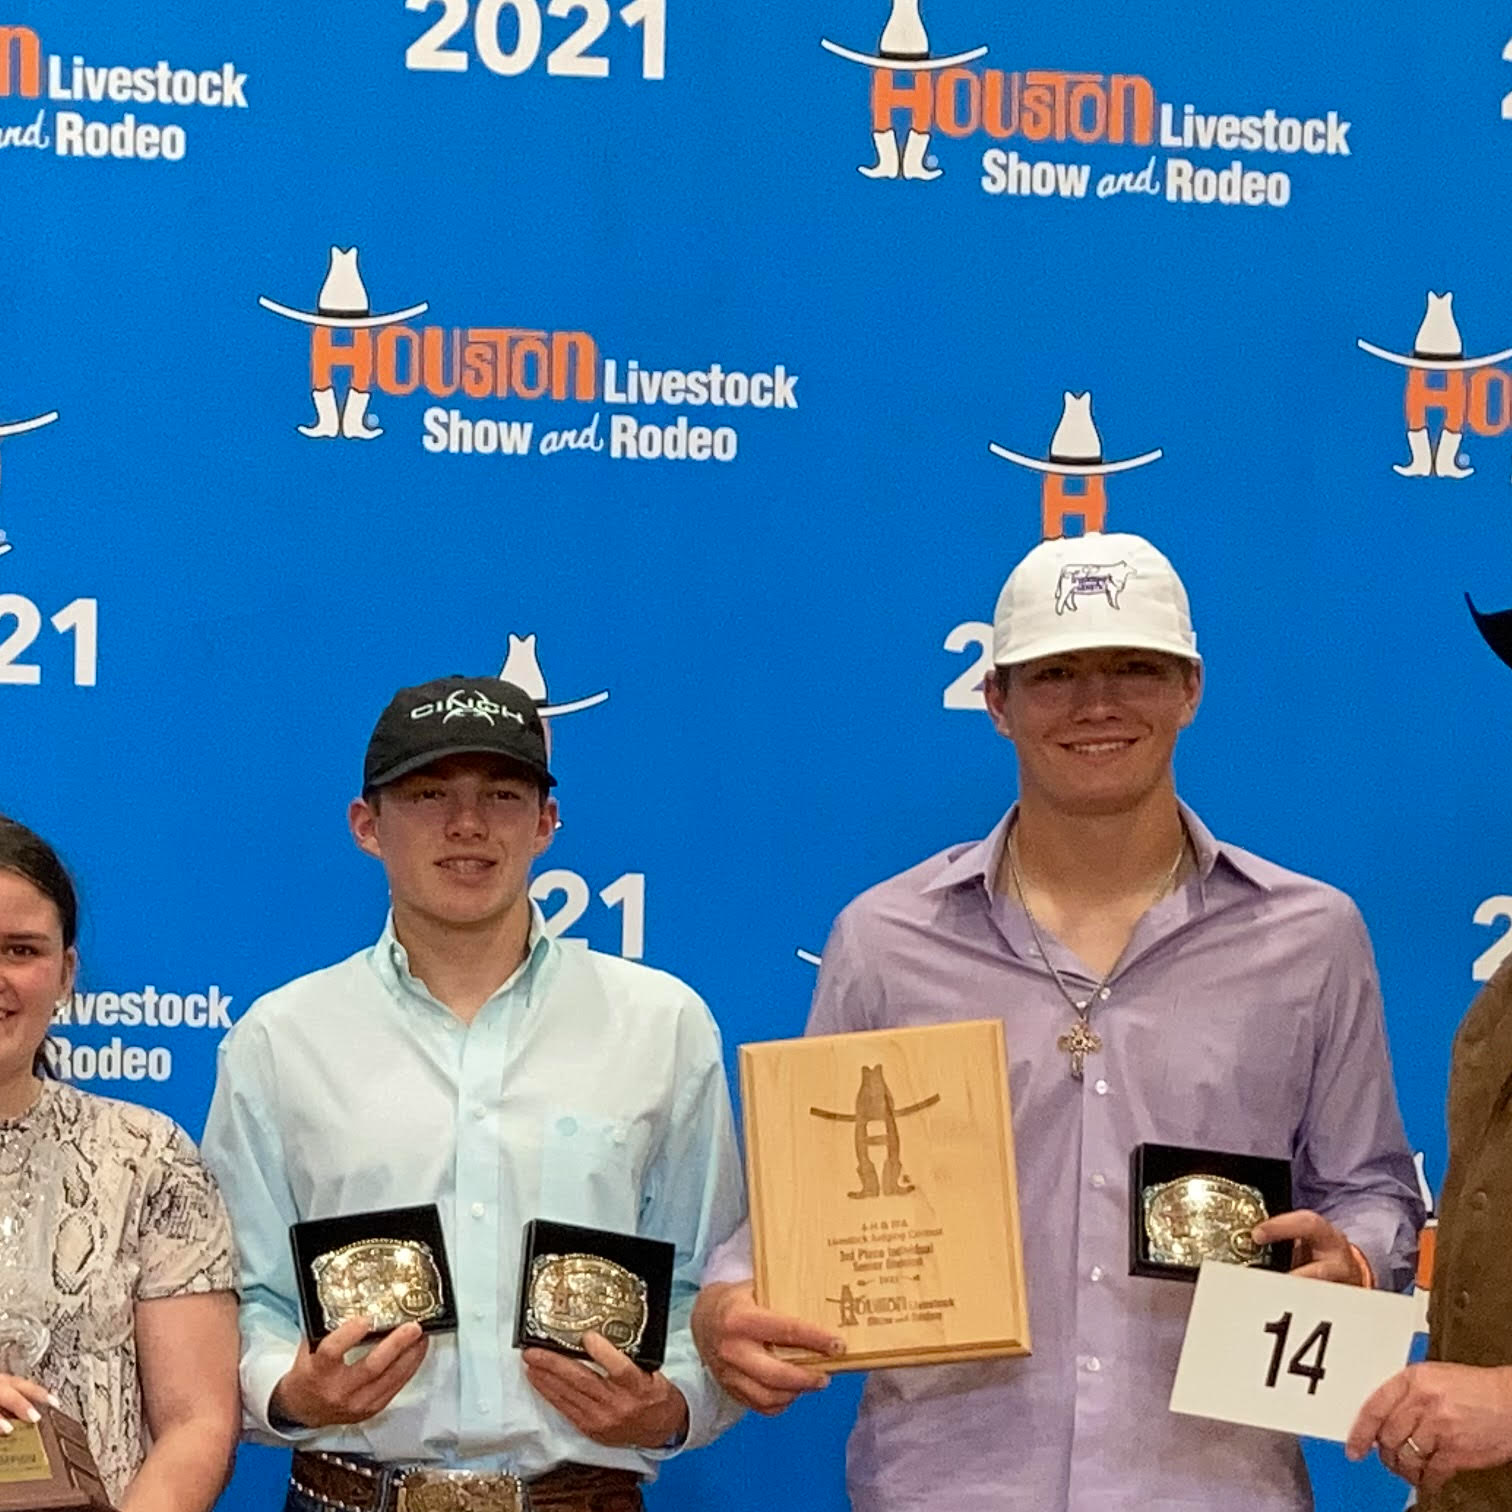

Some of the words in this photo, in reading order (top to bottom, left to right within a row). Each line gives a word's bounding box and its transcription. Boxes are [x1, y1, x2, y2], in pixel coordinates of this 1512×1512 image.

[405, 0, 666, 80] 2021
[48, 55, 248, 108] Livestock
[55, 111, 186, 161] Rodeo
[1160, 103, 1351, 155] Livestock
[981, 148, 1091, 198] Show
[1096, 156, 1160, 199] and
[1165, 159, 1291, 207] Rodeo
[604, 359, 798, 409] Livestock
[422, 407, 533, 455] Show
[539, 413, 604, 455] and
[610, 415, 737, 461] Rodeo
[528, 869, 645, 959] 21
[61, 985, 233, 1028] vestock
[1263, 1311, 1333, 1396] 14
